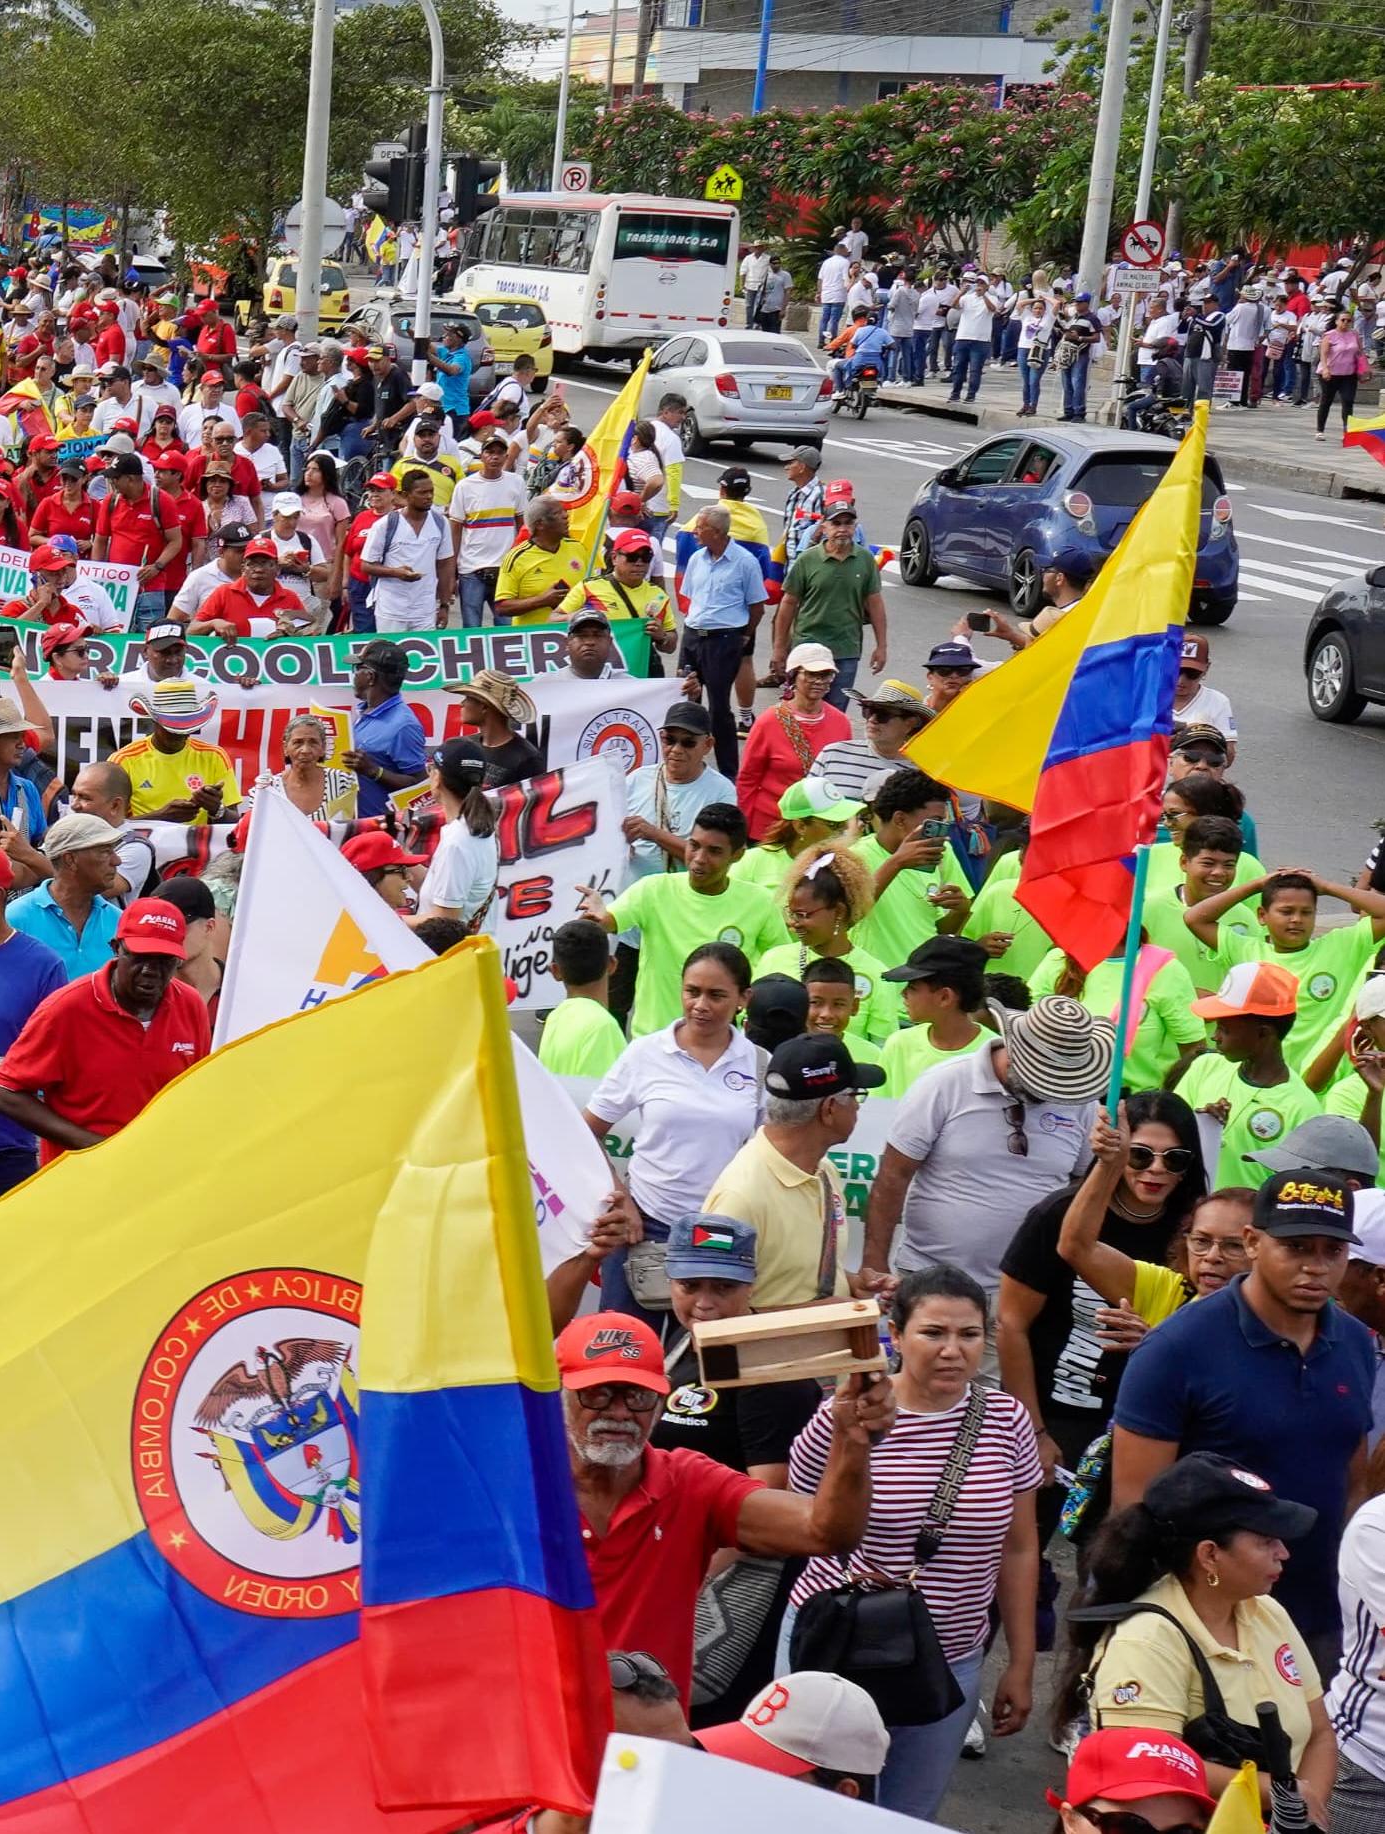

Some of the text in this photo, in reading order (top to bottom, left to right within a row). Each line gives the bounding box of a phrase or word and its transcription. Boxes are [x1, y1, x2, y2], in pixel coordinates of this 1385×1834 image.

[0, 551, 30, 569] DEL
[592, 1329, 634, 1345] NIKE
[662, 1411, 711, 1428] Atlántico
[748, 1684, 788, 1727] B
